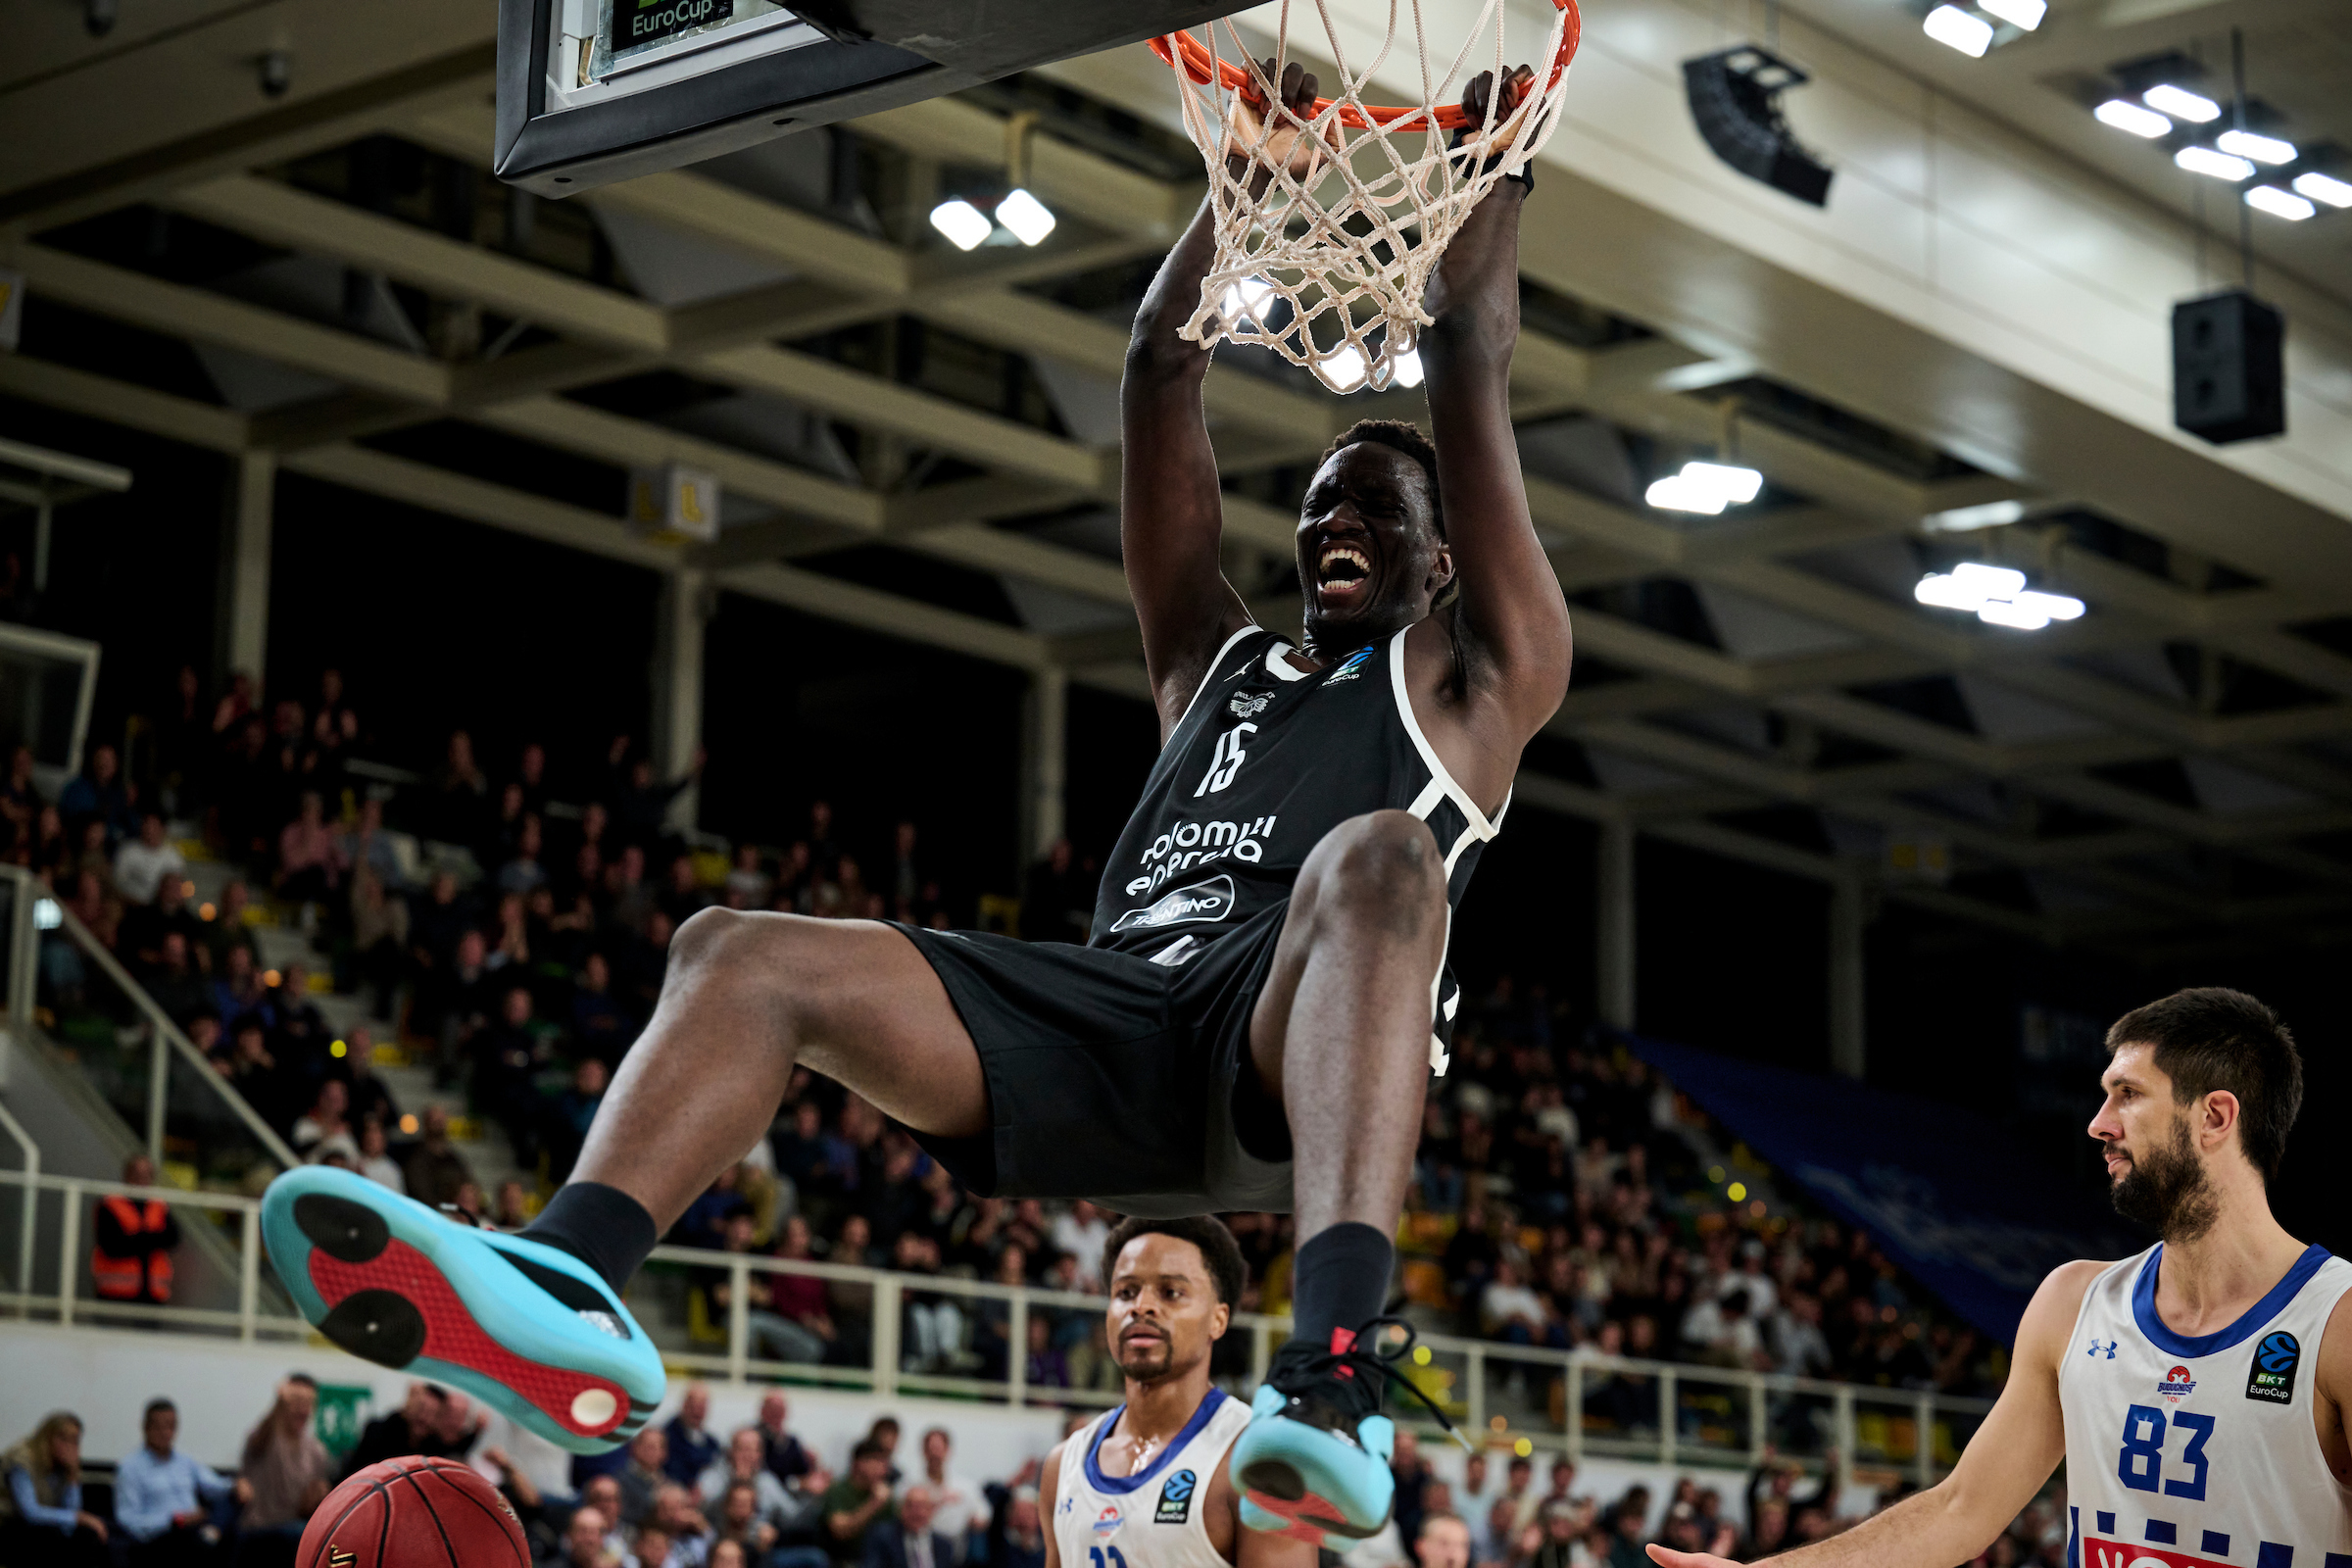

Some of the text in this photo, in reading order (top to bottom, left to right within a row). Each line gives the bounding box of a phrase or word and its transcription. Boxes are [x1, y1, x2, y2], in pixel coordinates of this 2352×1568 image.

[632, 0, 712, 36] EuroCup
[1193, 721, 1258, 798] 15
[1131, 897, 1222, 926] TRENTINO
[2249, 1385, 2289, 1399] EuroCup
[2257, 1374, 2286, 1385] BKT
[2118, 1403, 2216, 1501] 83
